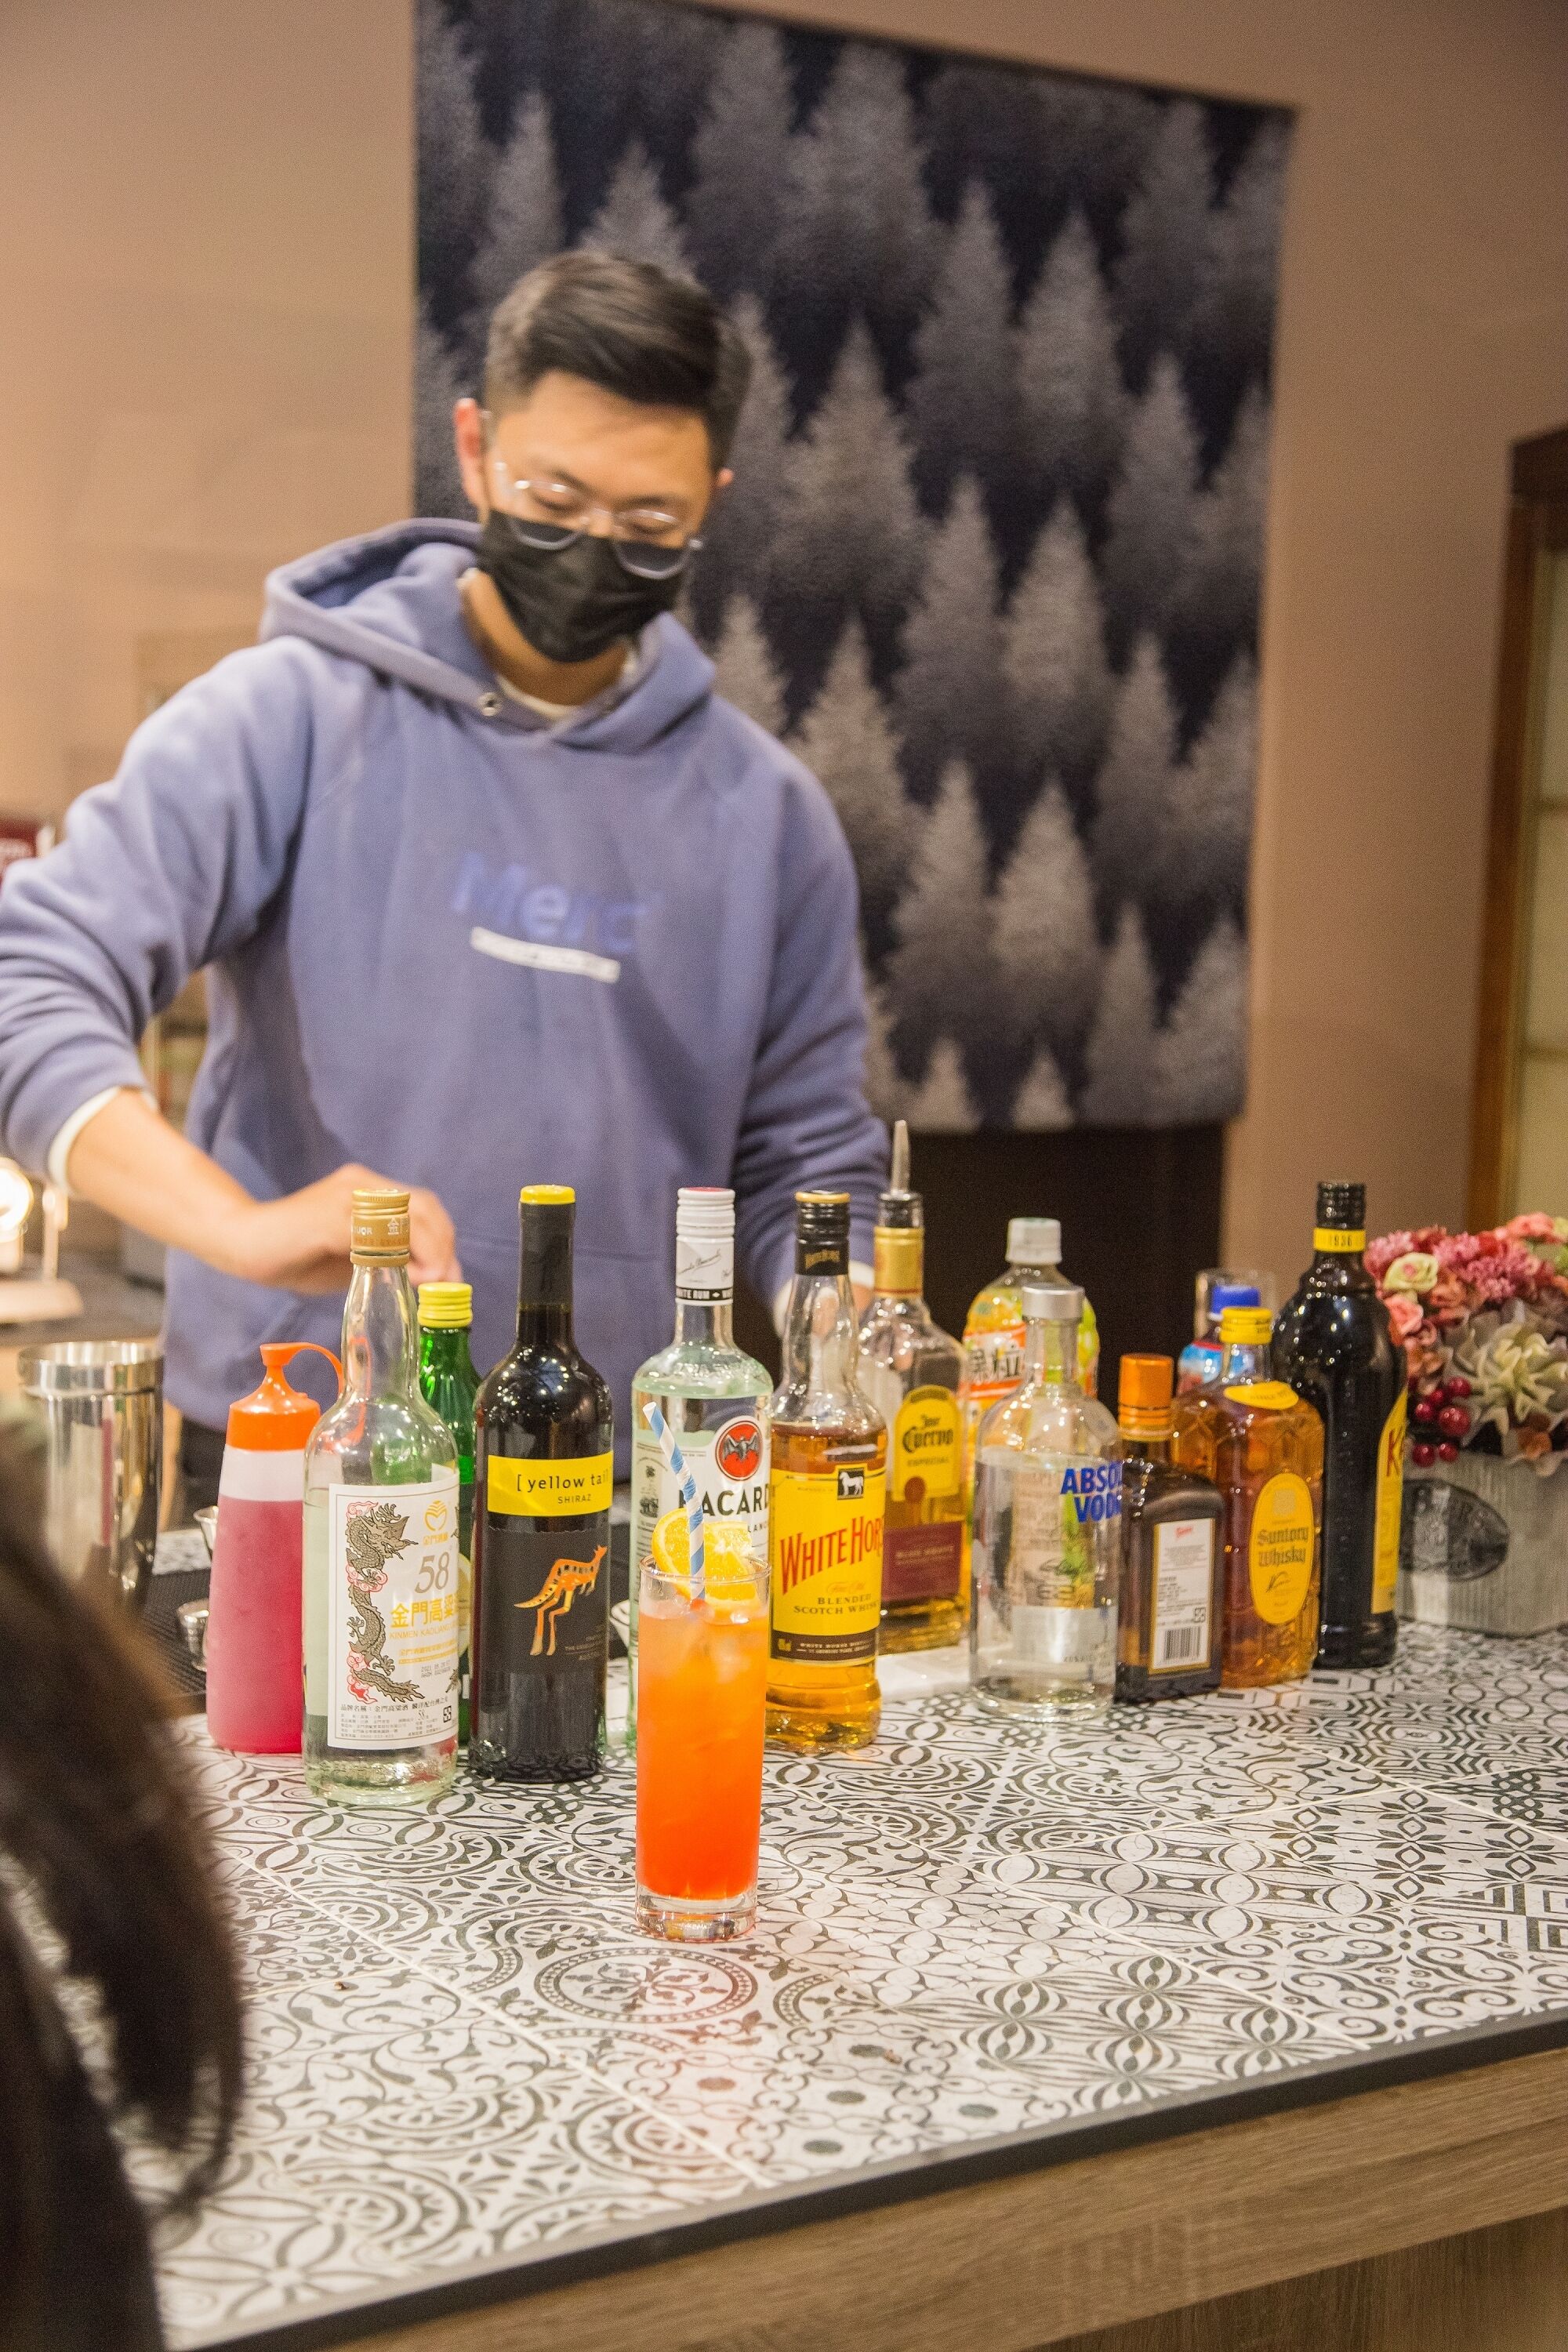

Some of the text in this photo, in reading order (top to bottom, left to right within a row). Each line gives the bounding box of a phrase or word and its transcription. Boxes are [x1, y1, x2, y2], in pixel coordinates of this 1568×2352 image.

[528, 1475, 585, 1493] yellow
[557, 1494, 592, 1504] SHIRAZ
[679, 1483, 769, 1516] ACAR
[1257, 1527, 1308, 1547] Suntory
[780, 1528, 848, 1595] WHITE
[1258, 1546, 1306, 1567] Whisky
[414, 1552, 450, 1594] 58
[818, 1593, 871, 1605] BLENDED
[793, 1606, 843, 1615] SCOTCH
[389, 1630, 418, 1639] KINMEN
